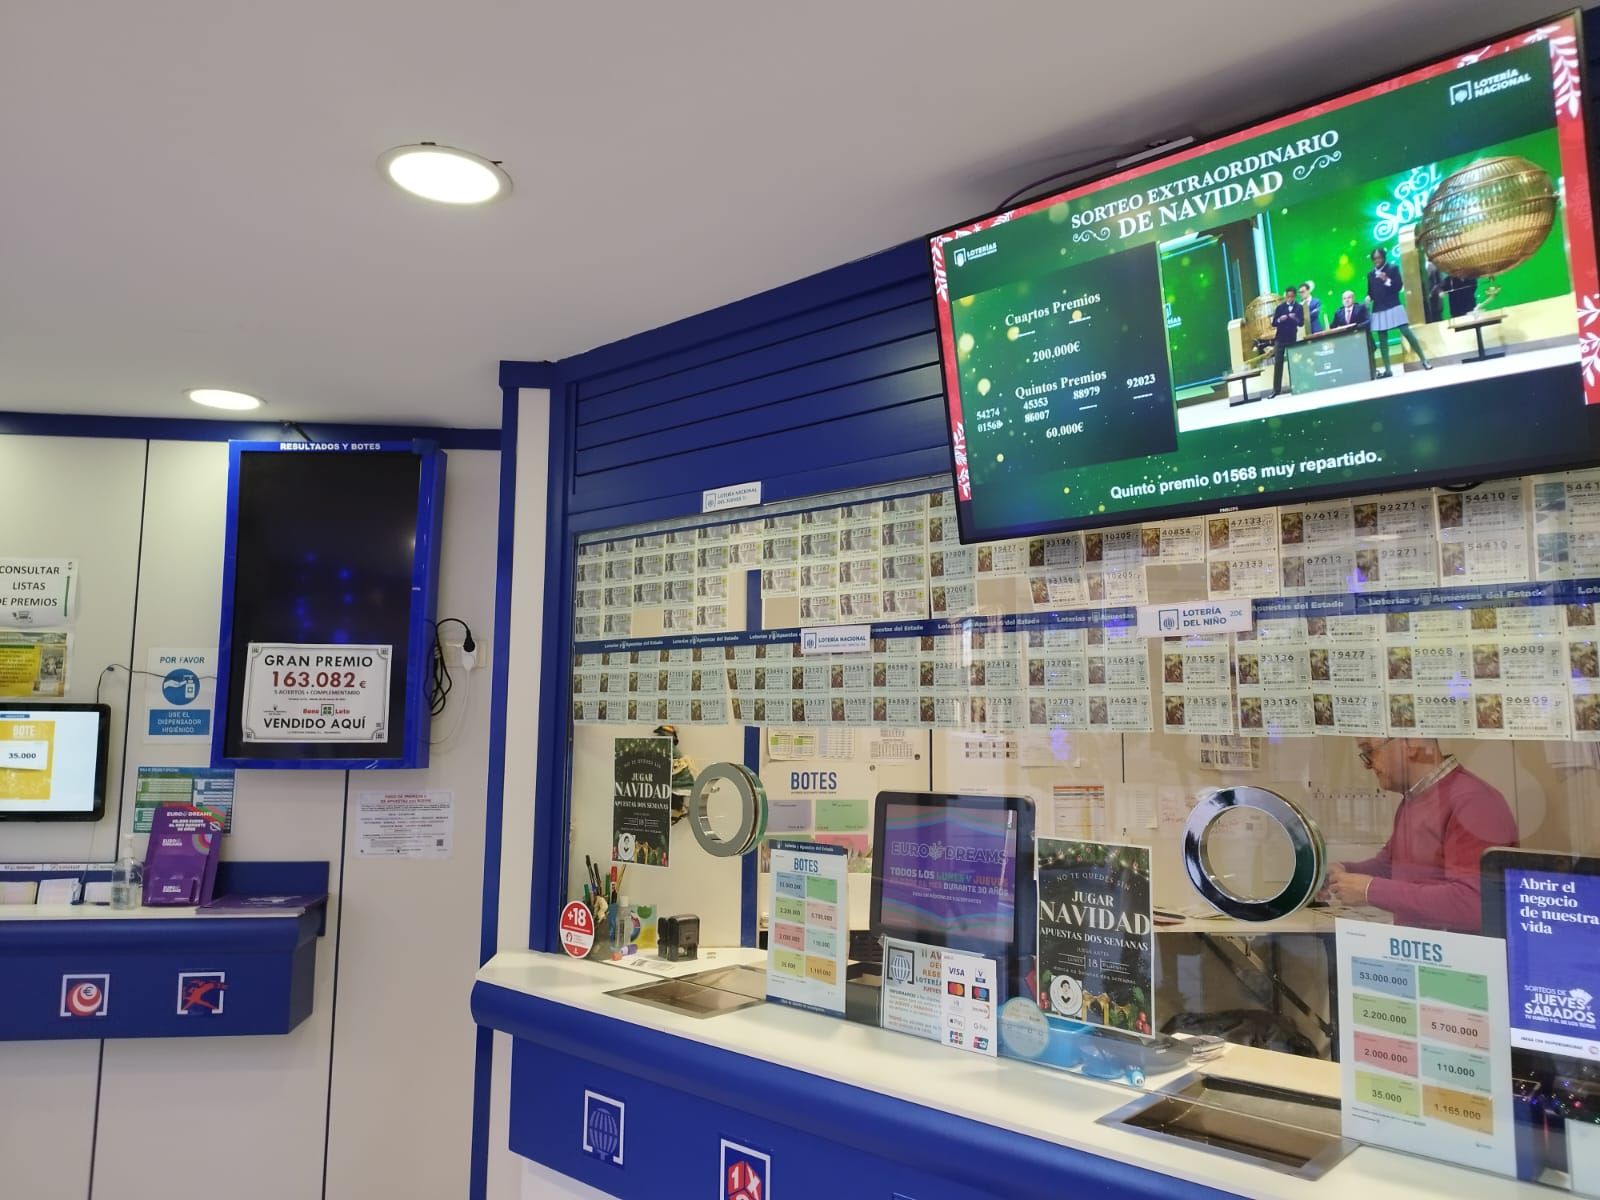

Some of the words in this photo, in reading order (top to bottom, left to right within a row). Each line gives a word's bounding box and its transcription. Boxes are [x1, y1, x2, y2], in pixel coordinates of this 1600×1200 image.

[1474, 69, 1519, 90] LOTERÍA
[1475, 73, 1531, 98] NACIONAL
[1071, 194, 1143, 229] SORTEO
[1148, 129, 1339, 205] EXTRAORDINARIO
[1118, 211, 1156, 239] DE
[1158, 169, 1283, 226] NAVIDAD
[1004, 304, 1050, 327] Cuartos
[1052, 291, 1101, 314] Premios
[1032, 340, 1081, 363] 200.000€
[1015, 379, 1058, 400] Quintos
[1060, 369, 1107, 391] Premios
[1127, 373, 1156, 389] 92023
[1073, 386, 1101, 401] 88979
[1023, 397, 1049, 411] 45353
[976, 407, 1001, 421] 54274
[1024, 409, 1050, 424] 86007
[977, 420, 1001, 433] 01568
[1046, 421, 1084, 439] 60.000€
[280, 442, 340, 451] RESULTADOS
[1110, 482, 1155, 500] Quinto
[1159, 474, 1209, 496] premio
[1212, 466, 1257, 485] 01568
[1261, 462, 1296, 483] muy
[1300, 449, 1383, 474] repartido.
[1465, 492, 1505, 503] 54410
[1379, 503, 1416, 512] 92271
[1304, 511, 1339, 521] 67612
[1306, 555, 1342, 565] 67612
[0, 565, 60, 575] CONSULTAR
[12, 581, 46, 591] LISTAS
[10, 597, 58, 607] PREMIOS
[1486, 591, 1504, 600] del
[1183, 607, 1221, 617] LOTERÍA
[1294, 601, 1310, 610] del
[1311, 600, 1344, 609] Estado
[1183, 618, 1201, 627] DEL
[1203, 616, 1227, 626] NIÑO
[818, 636, 839, 644] LOTERÍA
[1503, 645, 1545, 655] 96909
[159, 656, 177, 664] POR
[179, 656, 205, 664] FAVOR
[264, 655, 310, 667] GRAN
[316, 655, 373, 667] PREMIO
[272, 671, 355, 688] 163.082
[359, 680, 367, 688] €
[1263, 698, 1299, 707] 33136
[1416, 696, 1457, 705] 50668
[1506, 696, 1549, 705] 96909
[157, 718, 201, 726] DISPENSADOR
[263, 718, 326, 729] VENDIDO
[331, 716, 367, 730] AQUÍ
[12, 725, 35, 737] BOTE
[631, 772, 653, 782] JUGAR
[790, 771, 837, 790] BOTES
[615, 781, 671, 800] NAVIDAD
[891, 840, 929, 858] EURO
[944, 845, 1009, 865] DREAMS
[794, 857, 818, 872] BOTES
[889, 866, 918, 878] TODOS
[918, 869, 935, 880] LOS
[1070, 872, 1080, 880] TE
[1082, 872, 1114, 884] QUEDES
[943, 883, 977, 894] DURANTE
[977, 884, 987, 894] 30
[988, 885, 1009, 896] AÑOS
[1519, 877, 1559, 892] Abrir
[1562, 881, 1576, 894] el
[1071, 890, 1114, 907] JUGAR
[1519, 893, 1578, 909] negocio
[567, 907, 586, 927] +18
[1039, 899, 1150, 936] NAVIDAD
[1519, 905, 1539, 919] de
[1541, 908, 1599, 925] nuestra
[1520, 920, 1552, 935] vida
[1040, 927, 1083, 941] APUESTAS
[1084, 933, 1102, 945] DOS
[1103, 936, 1149, 952] SEMANAS
[1389, 937, 1443, 963] BOTES
[1087, 957, 1098, 968] 18
[949, 967, 965, 976] VISA
[1359, 971, 1408, 987] 53.000.000
[1524, 985, 1556, 995] SORTEOS
[1531, 992, 1586, 1011] JUEVES
[1362, 1009, 1407, 1024] 2.200.000
[1524, 1001, 1596, 1024] SÁBADOS
[1431, 1021, 1479, 1038] 5.700.000
[1364, 1048, 1408, 1064] 2.000.000
[1436, 1062, 1475, 1078] 110.000
[1371, 1089, 1402, 1103] 35.000
[1433, 1103, 1482, 1121] 1.165.000
